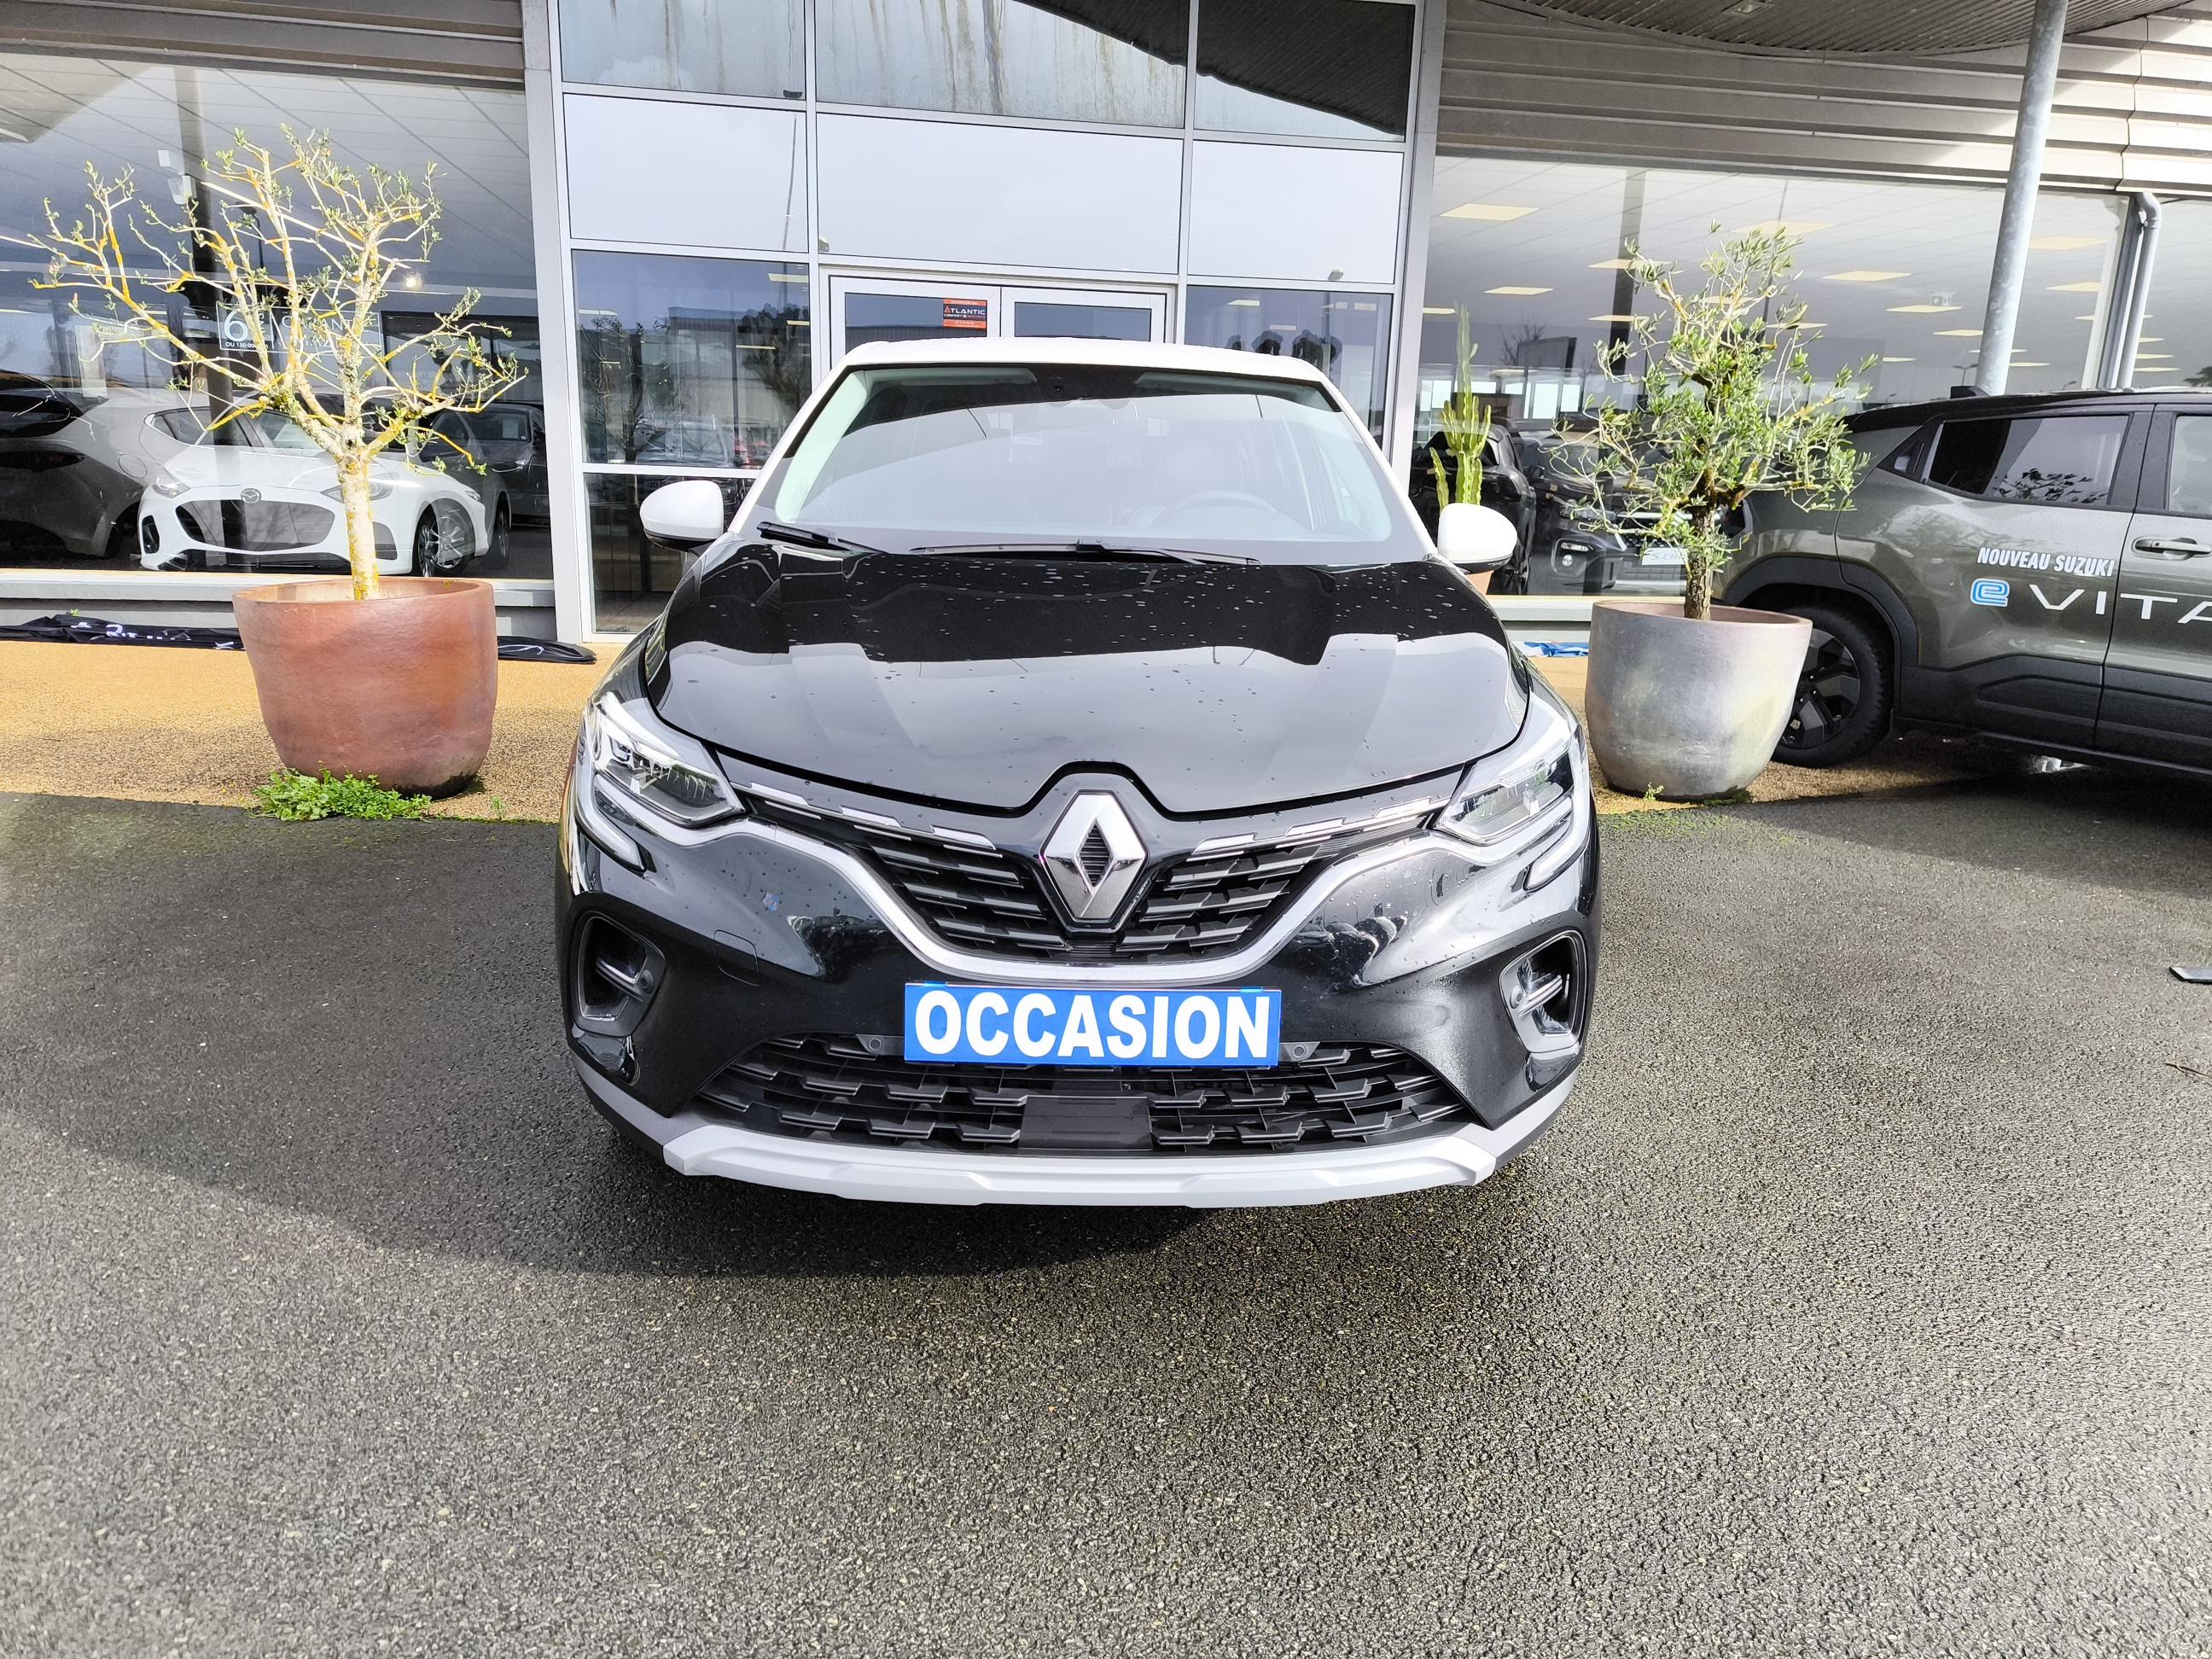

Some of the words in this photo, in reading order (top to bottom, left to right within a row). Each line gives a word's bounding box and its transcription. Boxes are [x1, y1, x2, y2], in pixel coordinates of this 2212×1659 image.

[224, 309, 248, 341] 6
[944, 306, 986, 315] ATLANTIC
[1977, 547, 2050, 570] NOUVEAU
[2054, 556, 2115, 577] SUZUKI
[915, 990, 1270, 1058] OCCASION
